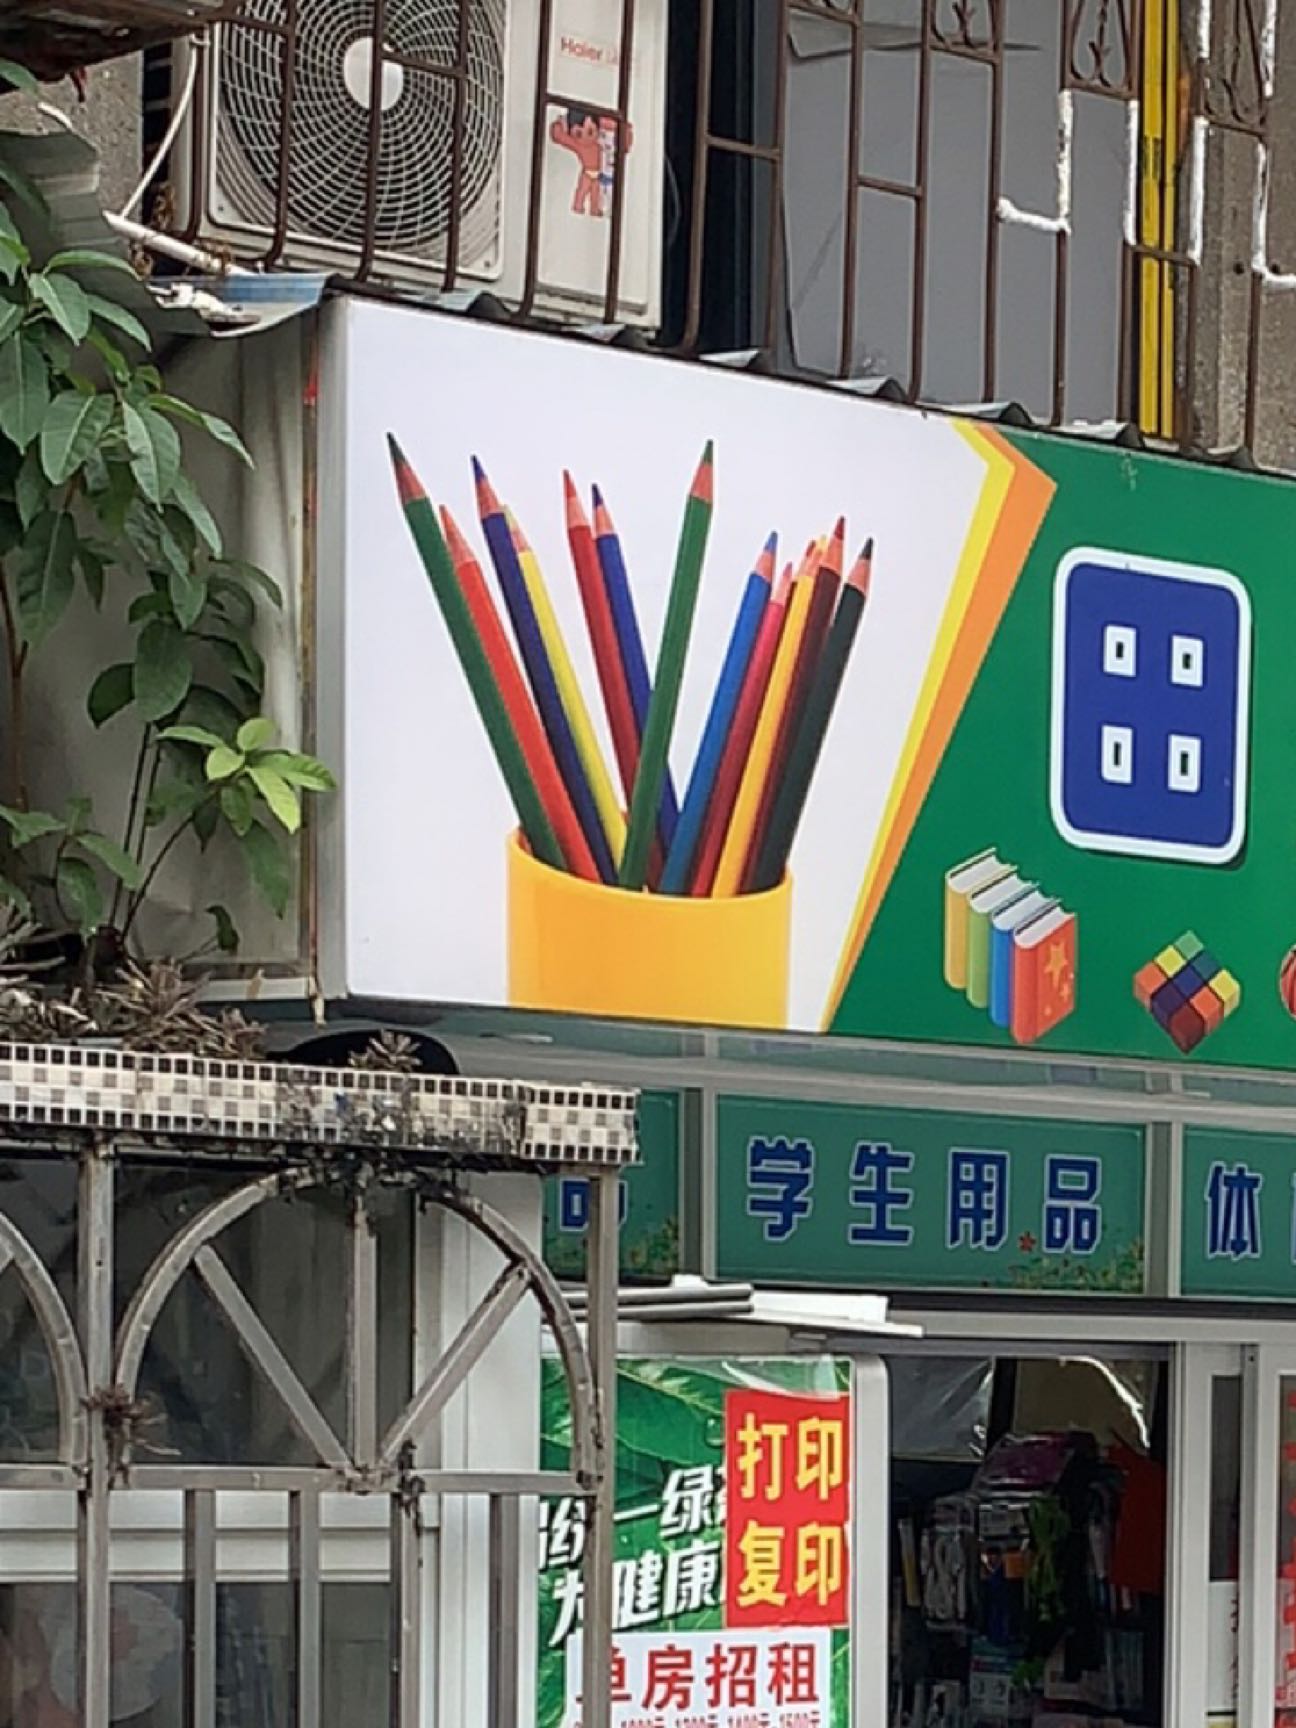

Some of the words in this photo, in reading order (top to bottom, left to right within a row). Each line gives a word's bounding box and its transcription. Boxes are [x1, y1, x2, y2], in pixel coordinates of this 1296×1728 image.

[746, 1136, 1100, 1254] 学生用品
[736, 1411, 844, 1501] 打印
[736, 1519, 844, 1607] 复印
